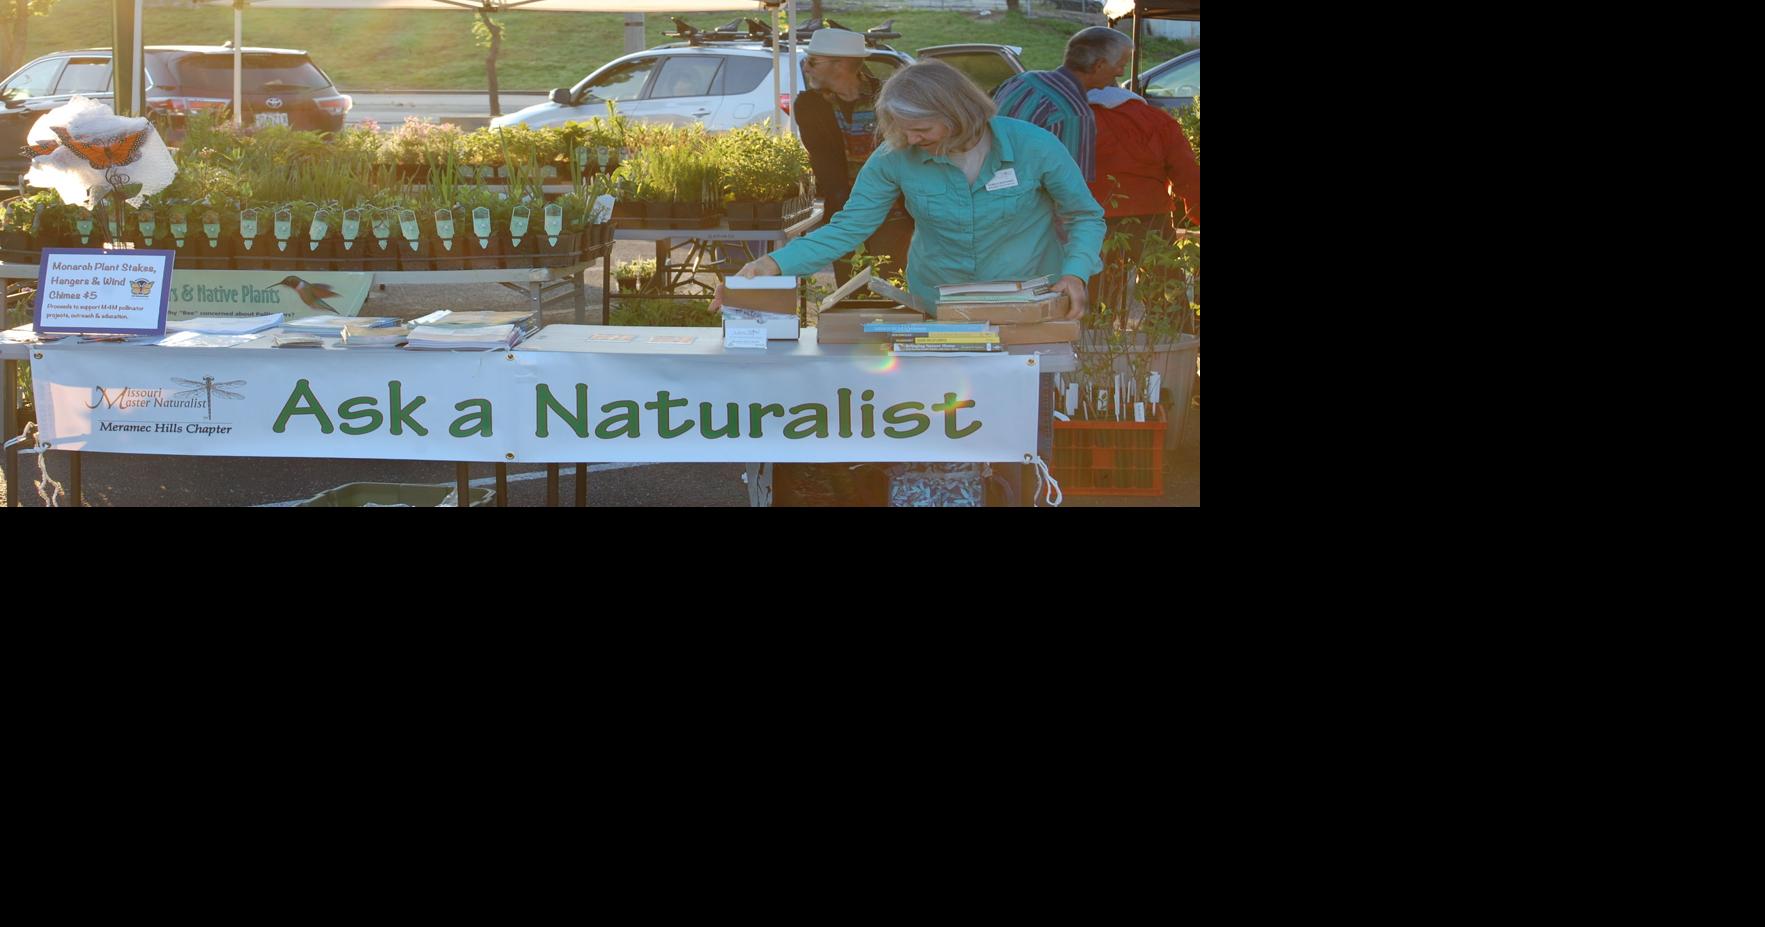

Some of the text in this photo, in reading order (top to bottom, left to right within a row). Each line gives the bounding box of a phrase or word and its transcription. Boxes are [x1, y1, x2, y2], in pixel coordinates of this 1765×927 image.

[52, 262, 157, 273] Monarch Plant Stakes,
[51, 277, 126, 287] Hangers & Wind
[49, 290, 98, 300] Chimes $5
[181, 284, 194, 302] &
[197, 286, 239, 303] Native
[241, 284, 280, 304] Plants
[153, 397, 207, 409] Naturalist
[272, 378, 983, 440] Ask a Naturalist
[100, 421, 232, 436] Meramec Hills Chapter
